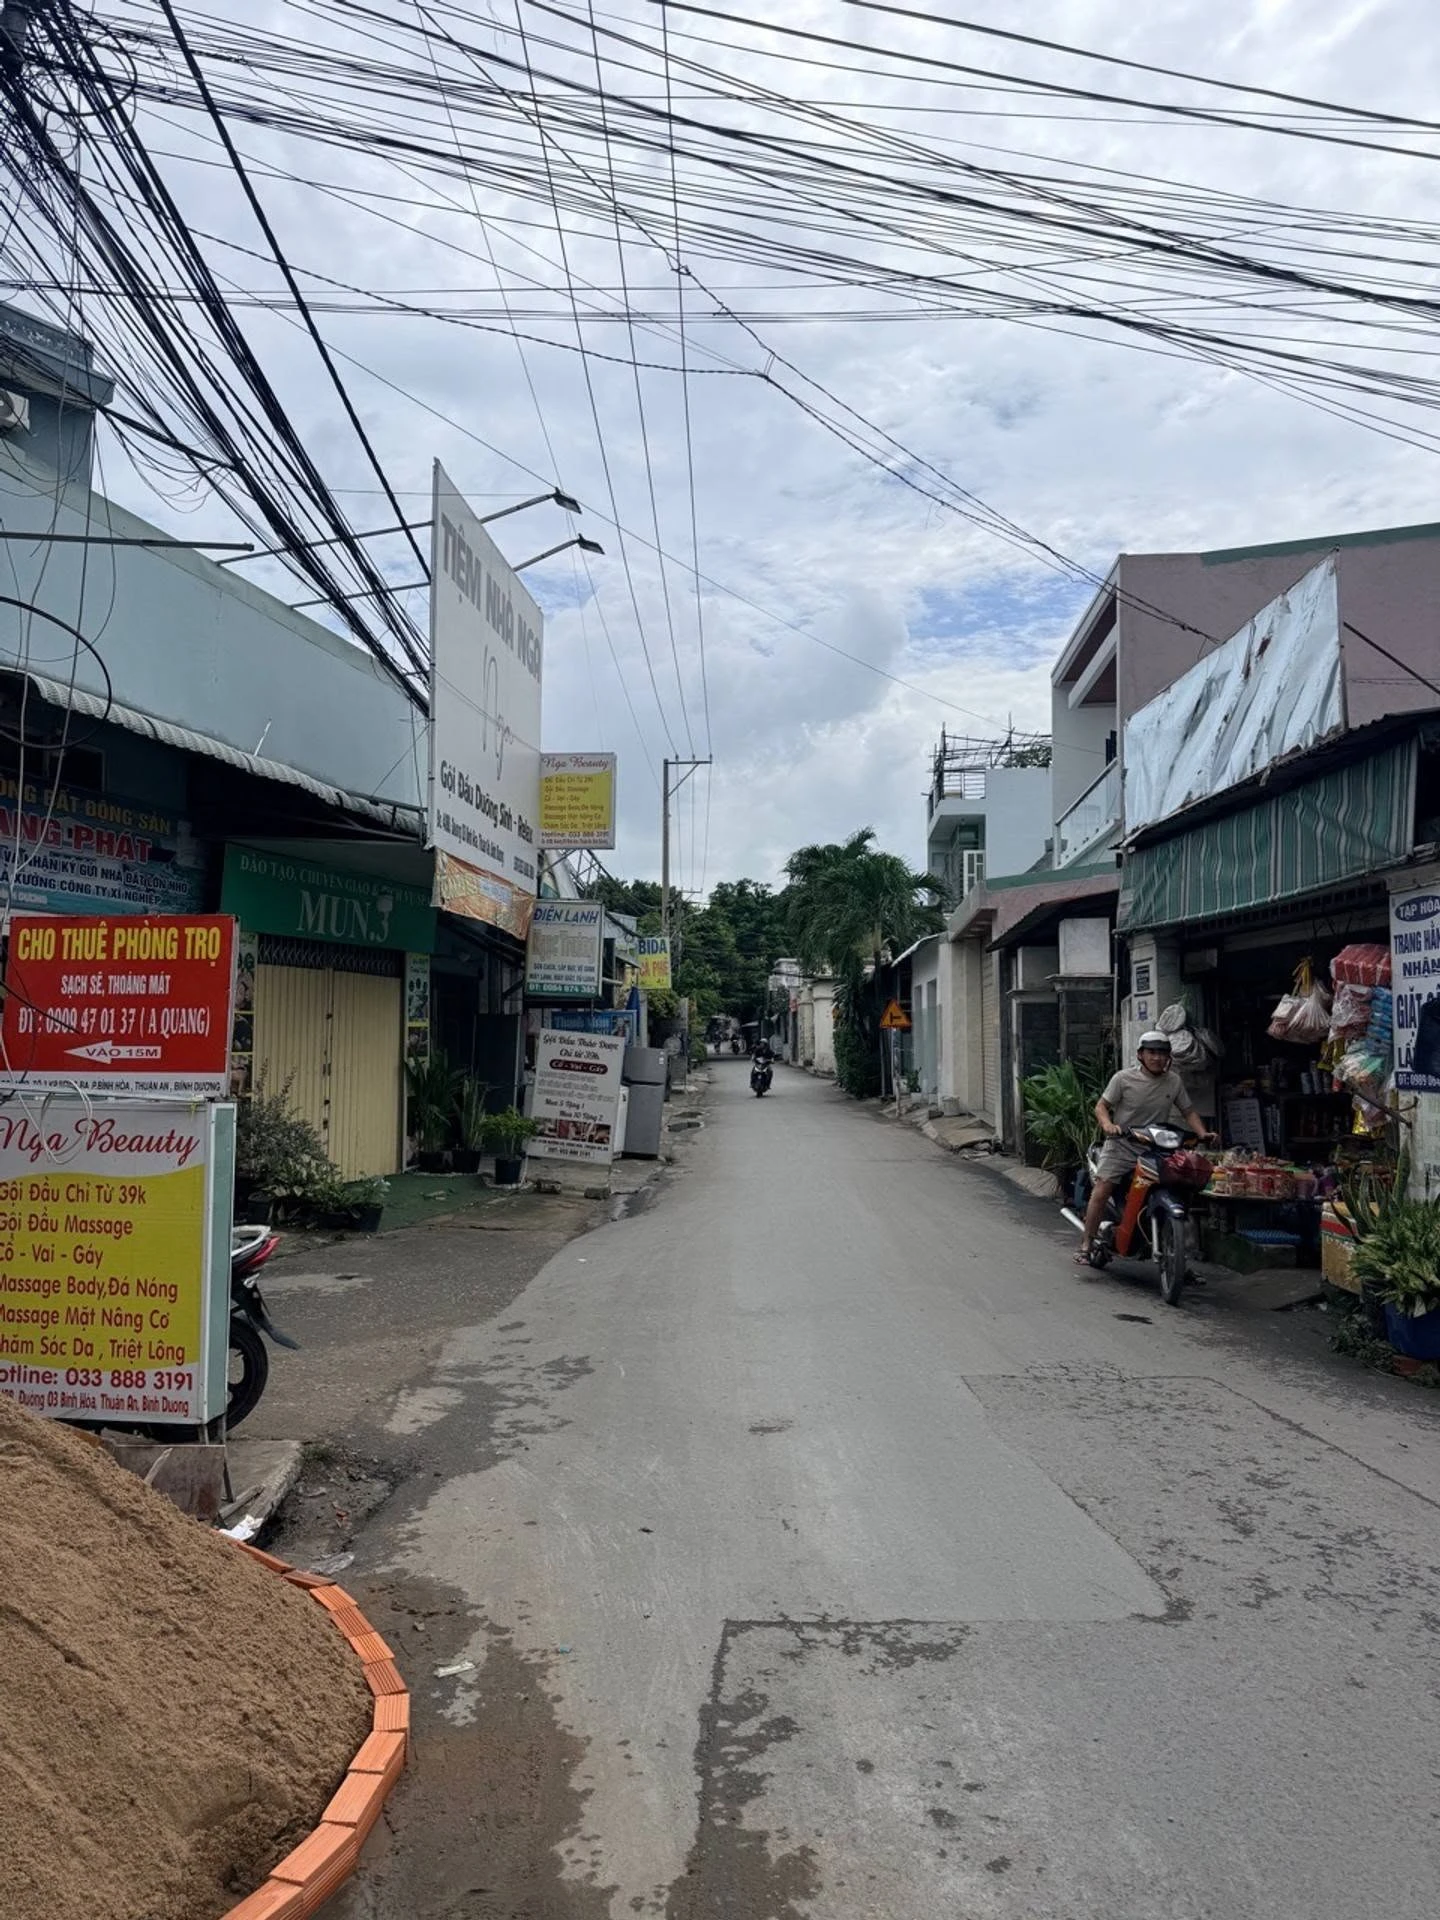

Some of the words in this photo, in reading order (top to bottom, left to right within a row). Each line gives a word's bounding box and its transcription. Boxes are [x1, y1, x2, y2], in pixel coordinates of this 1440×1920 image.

[71, 823, 152, 864] PHÁT
[18, 928, 55, 960] CHO
[61, 921, 108, 960] THUÊ
[113, 920, 179, 960] PHÒNG
[184, 926, 221, 967] TRỌ
[639, 939, 668, 954] BIDA
[1394, 932, 1422, 954] TRANG
[61, 974, 88, 998] SẠCH
[108, 971, 147, 995] THOÁNG
[149, 971, 171, 995] MÁT
[80, 1008, 96, 1033] 47
[100, 1008, 115, 1033] 01
[120, 1008, 136, 1033] 37
[127, 1047, 158, 1057] 15M
[1398, 1039, 1416, 1070] LẤ
[0, 1116, 68, 1163] Nga
[75, 1117, 200, 1166] Beauty
[0, 1181, 23, 1207] Gội
[29, 1176, 60, 1201] Đầu
[66, 1182, 90, 1203] Chỉ
[95, 1182, 115, 1203] Từ
[118, 1185, 147, 1205] 39k
[28, 1206, 58, 1233] Đầu
[64, 1218, 133, 1240] Massage
[32, 1243, 54, 1262] Vai
[73, 1244, 104, 1269] Gáy
[136, 1277, 178, 1303] Nóng
[65, 1306, 95, 1331] Mặt
[101, 1307, 143, 1333] Nâng
[150, 1309, 170, 1329] Cơ
[0, 1334, 34, 1354] hăm
[40, 1335, 67, 1356] Sóc
[109, 1338, 143, 1364] Triệt
[148, 1340, 186, 1365] Lông
[0, 1365, 58, 1384] otline:
[65, 1367, 102, 1387] 033
[110, 1369, 146, 1388] 888
[153, 1371, 193, 1391] 3191
[47, 1391, 58, 1407] 03
